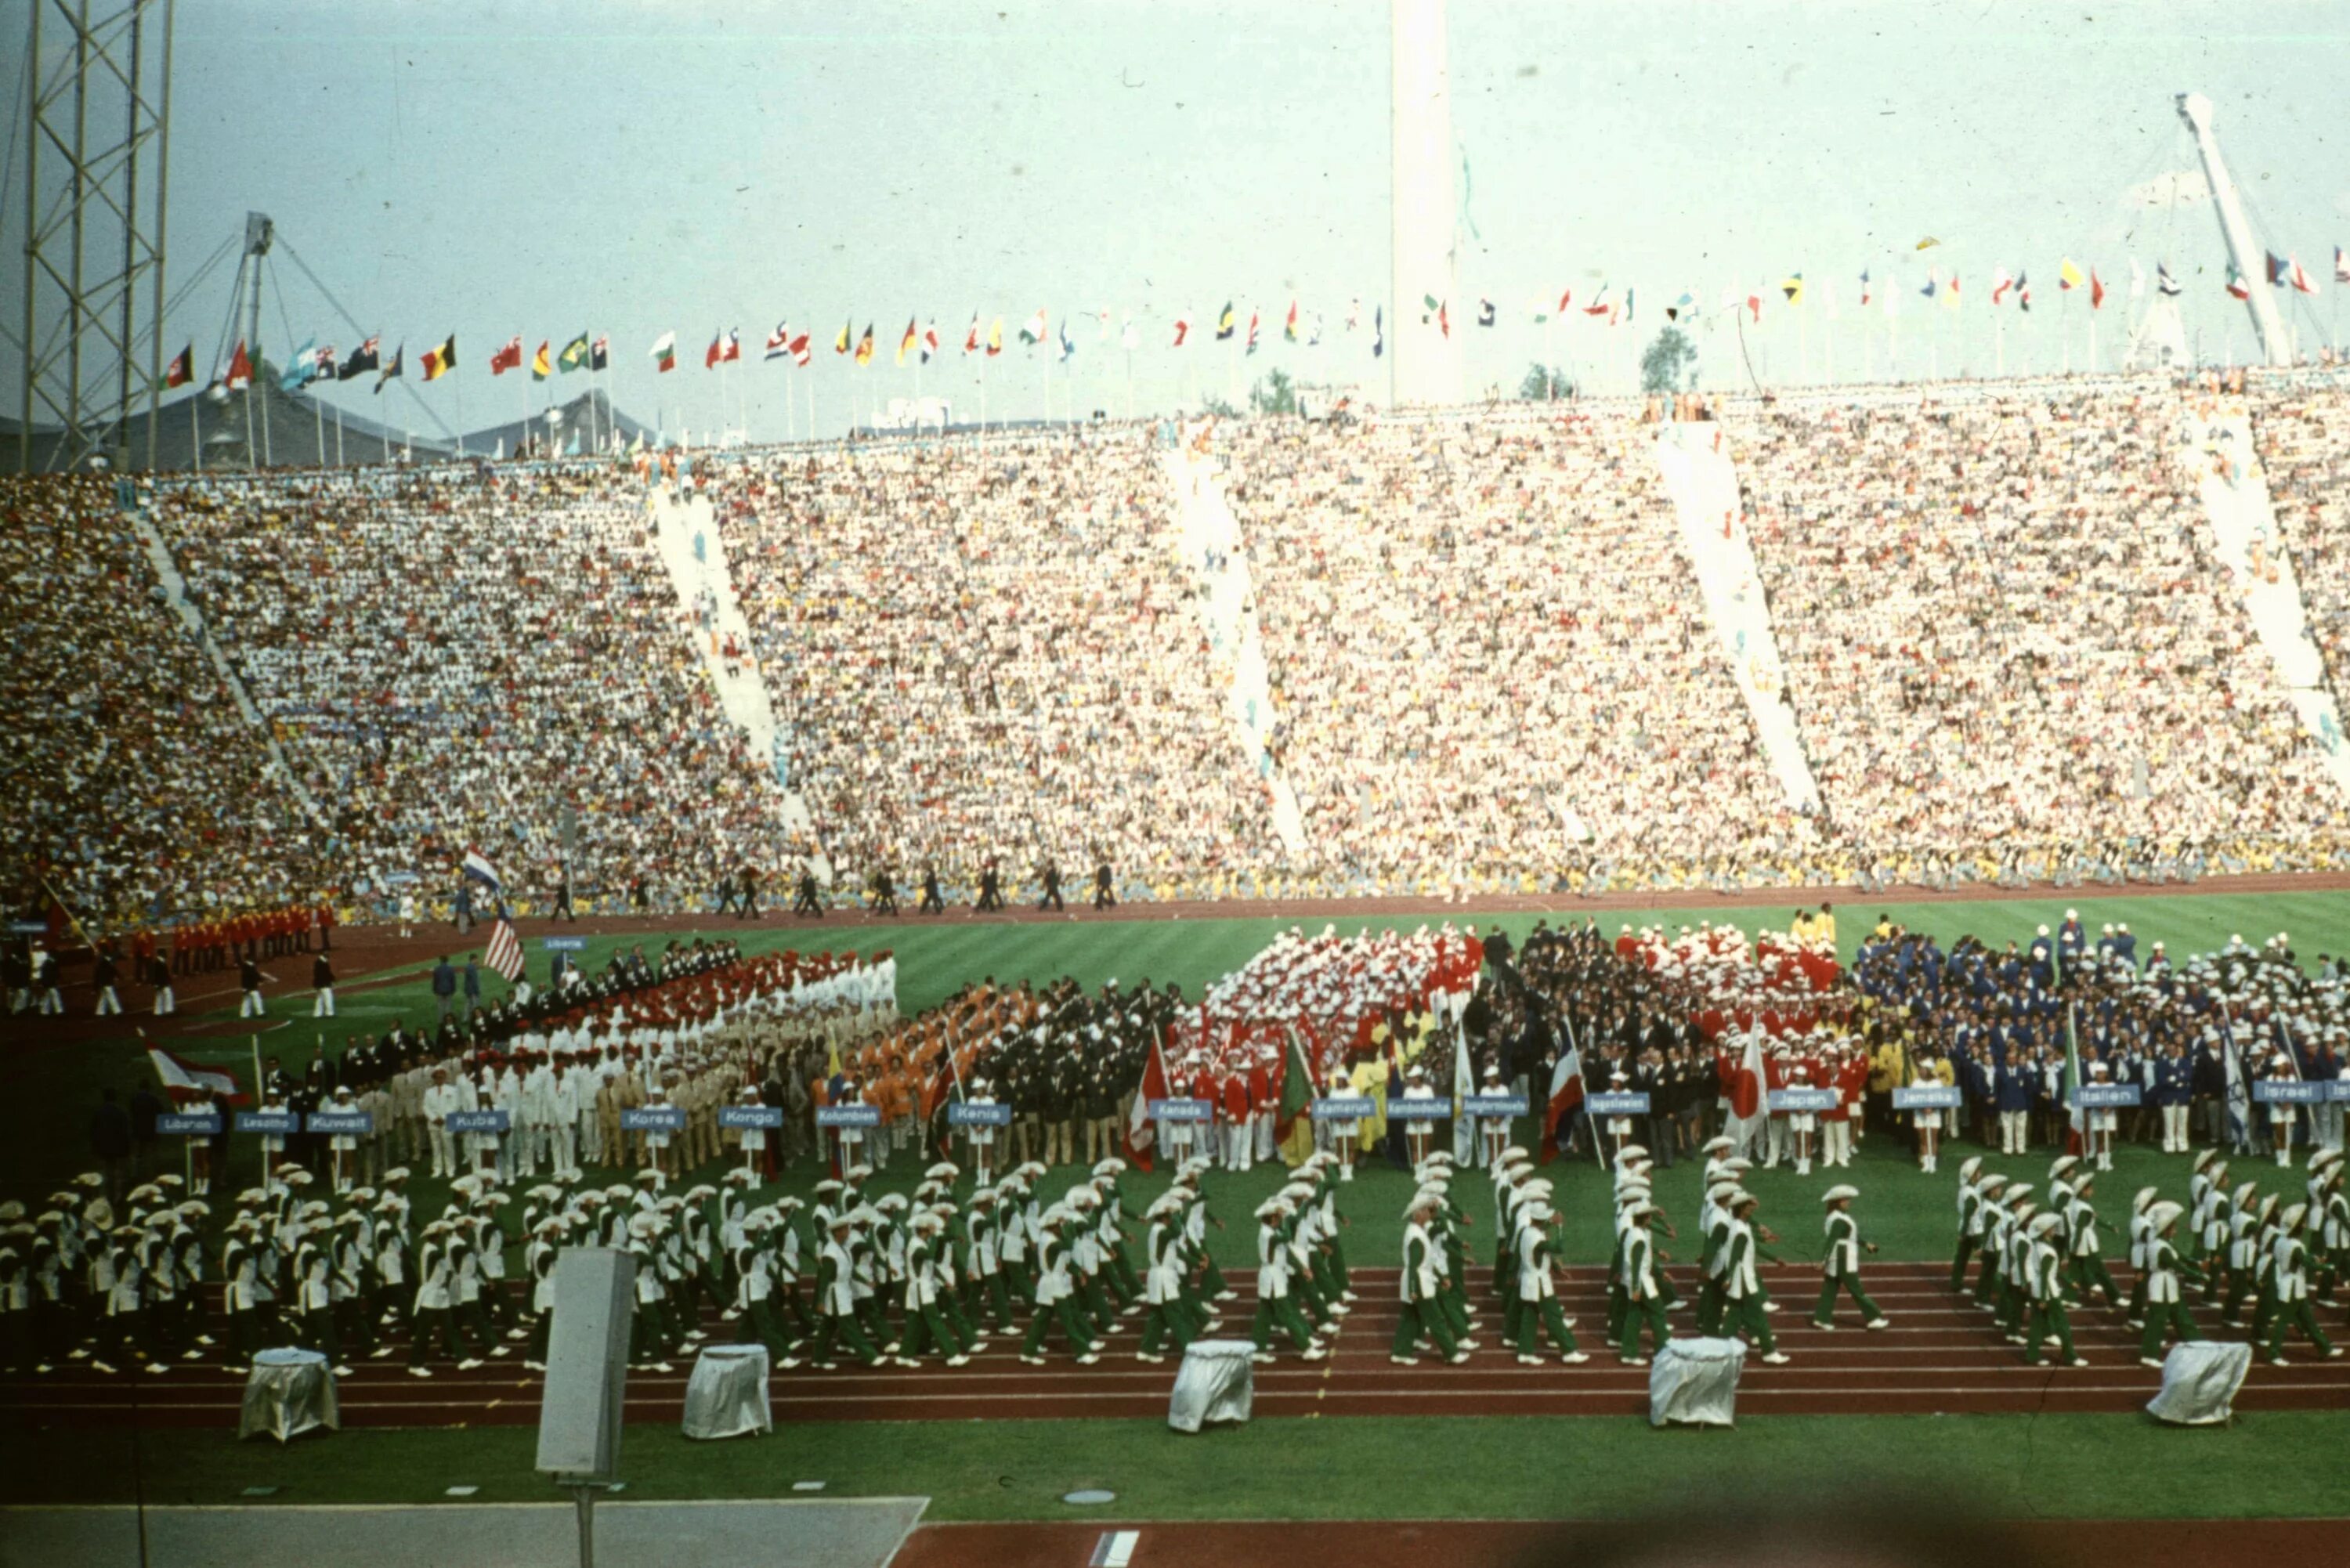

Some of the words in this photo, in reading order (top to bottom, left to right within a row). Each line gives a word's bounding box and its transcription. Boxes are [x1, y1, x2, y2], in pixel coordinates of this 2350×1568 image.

[2080, 1089, 2131, 1101] Italien
[2265, 1086, 2312, 1097] Israel
[1779, 1094, 1827, 1107] Japan
[1904, 1093, 1953, 1104] Jamaika
[958, 1108, 1000, 1119] Kenia
[1159, 1103, 1202, 1115] Kanada
[1318, 1103, 1370, 1114] Kamerun
[457, 1116, 497, 1126] Kuba
[630, 1113, 675, 1124] Korea
[726, 1111, 774, 1125] Kongo
[819, 1110, 877, 1122] Kolumbien
[244, 1118, 290, 1128] Lesotho
[313, 1117, 367, 1128] Kuwait
